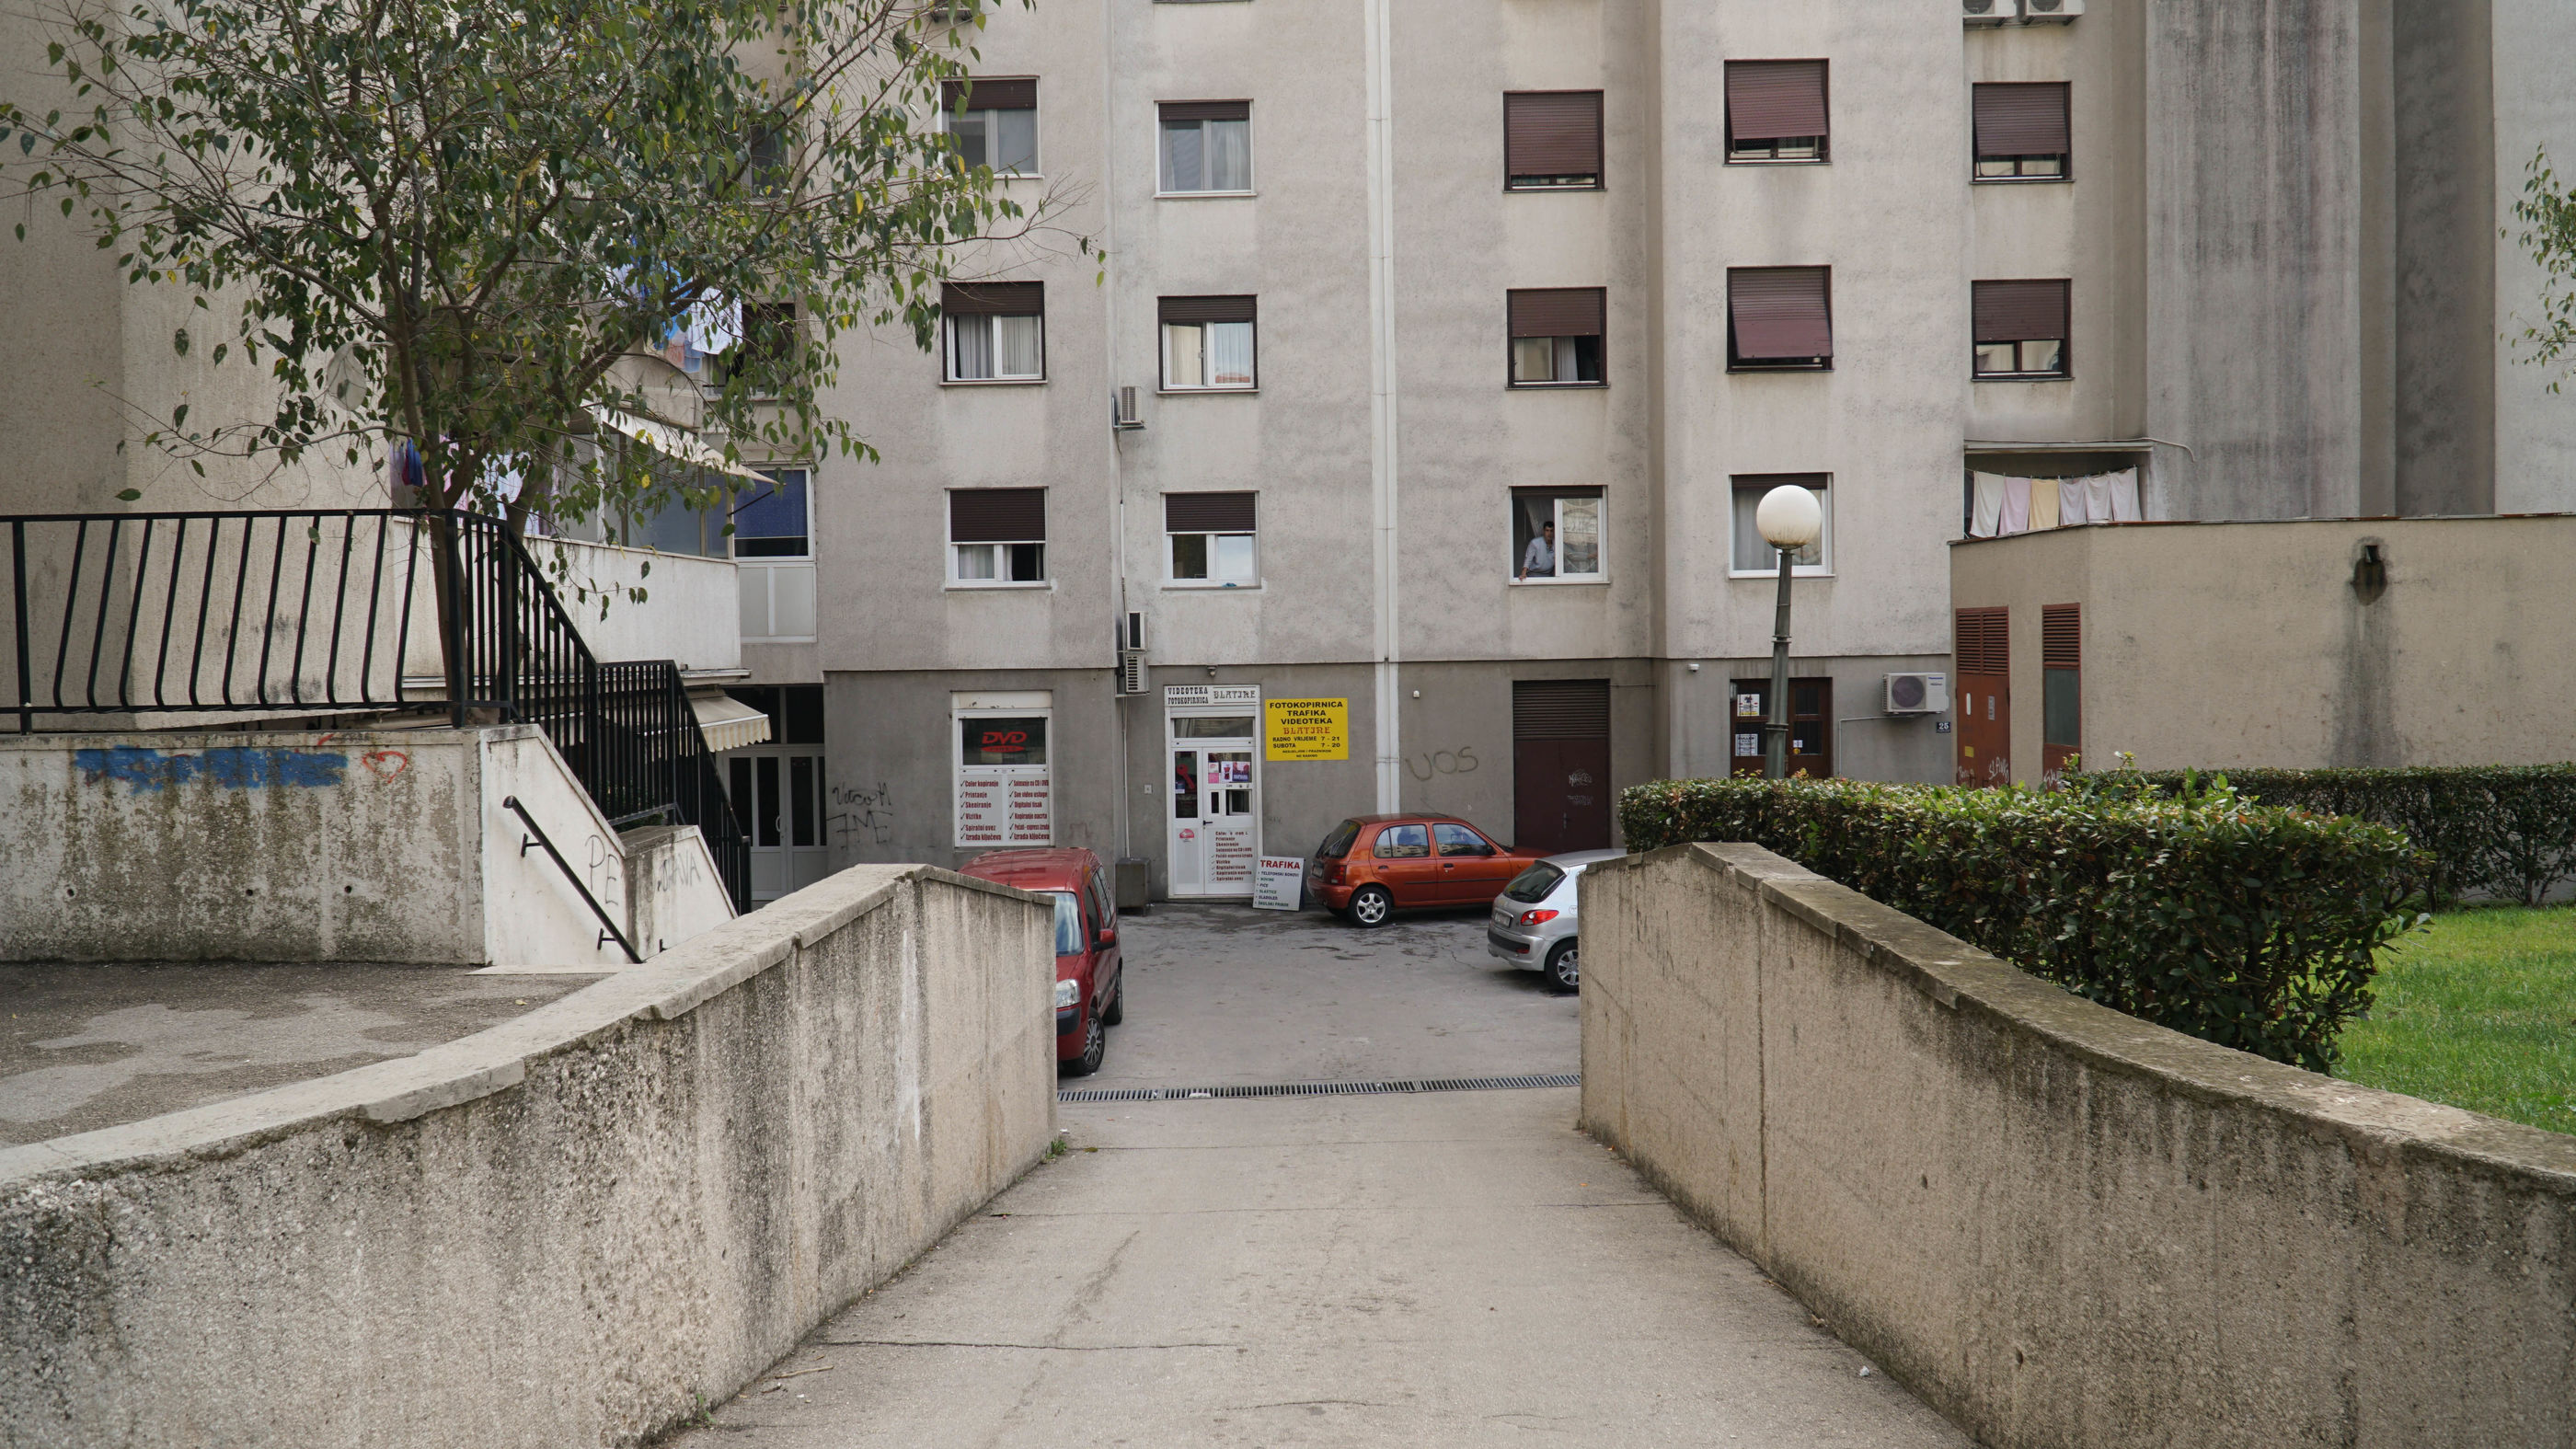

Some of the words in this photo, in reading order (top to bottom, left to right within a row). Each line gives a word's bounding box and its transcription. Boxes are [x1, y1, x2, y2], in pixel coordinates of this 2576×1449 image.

[1167, 696, 1209, 705] FOTOKOPIRNICA
[982, 731, 1028, 744] DVD
[1029, 833, 1050, 841] ključeva
[1259, 859, 1301, 869] TRAFIKA
